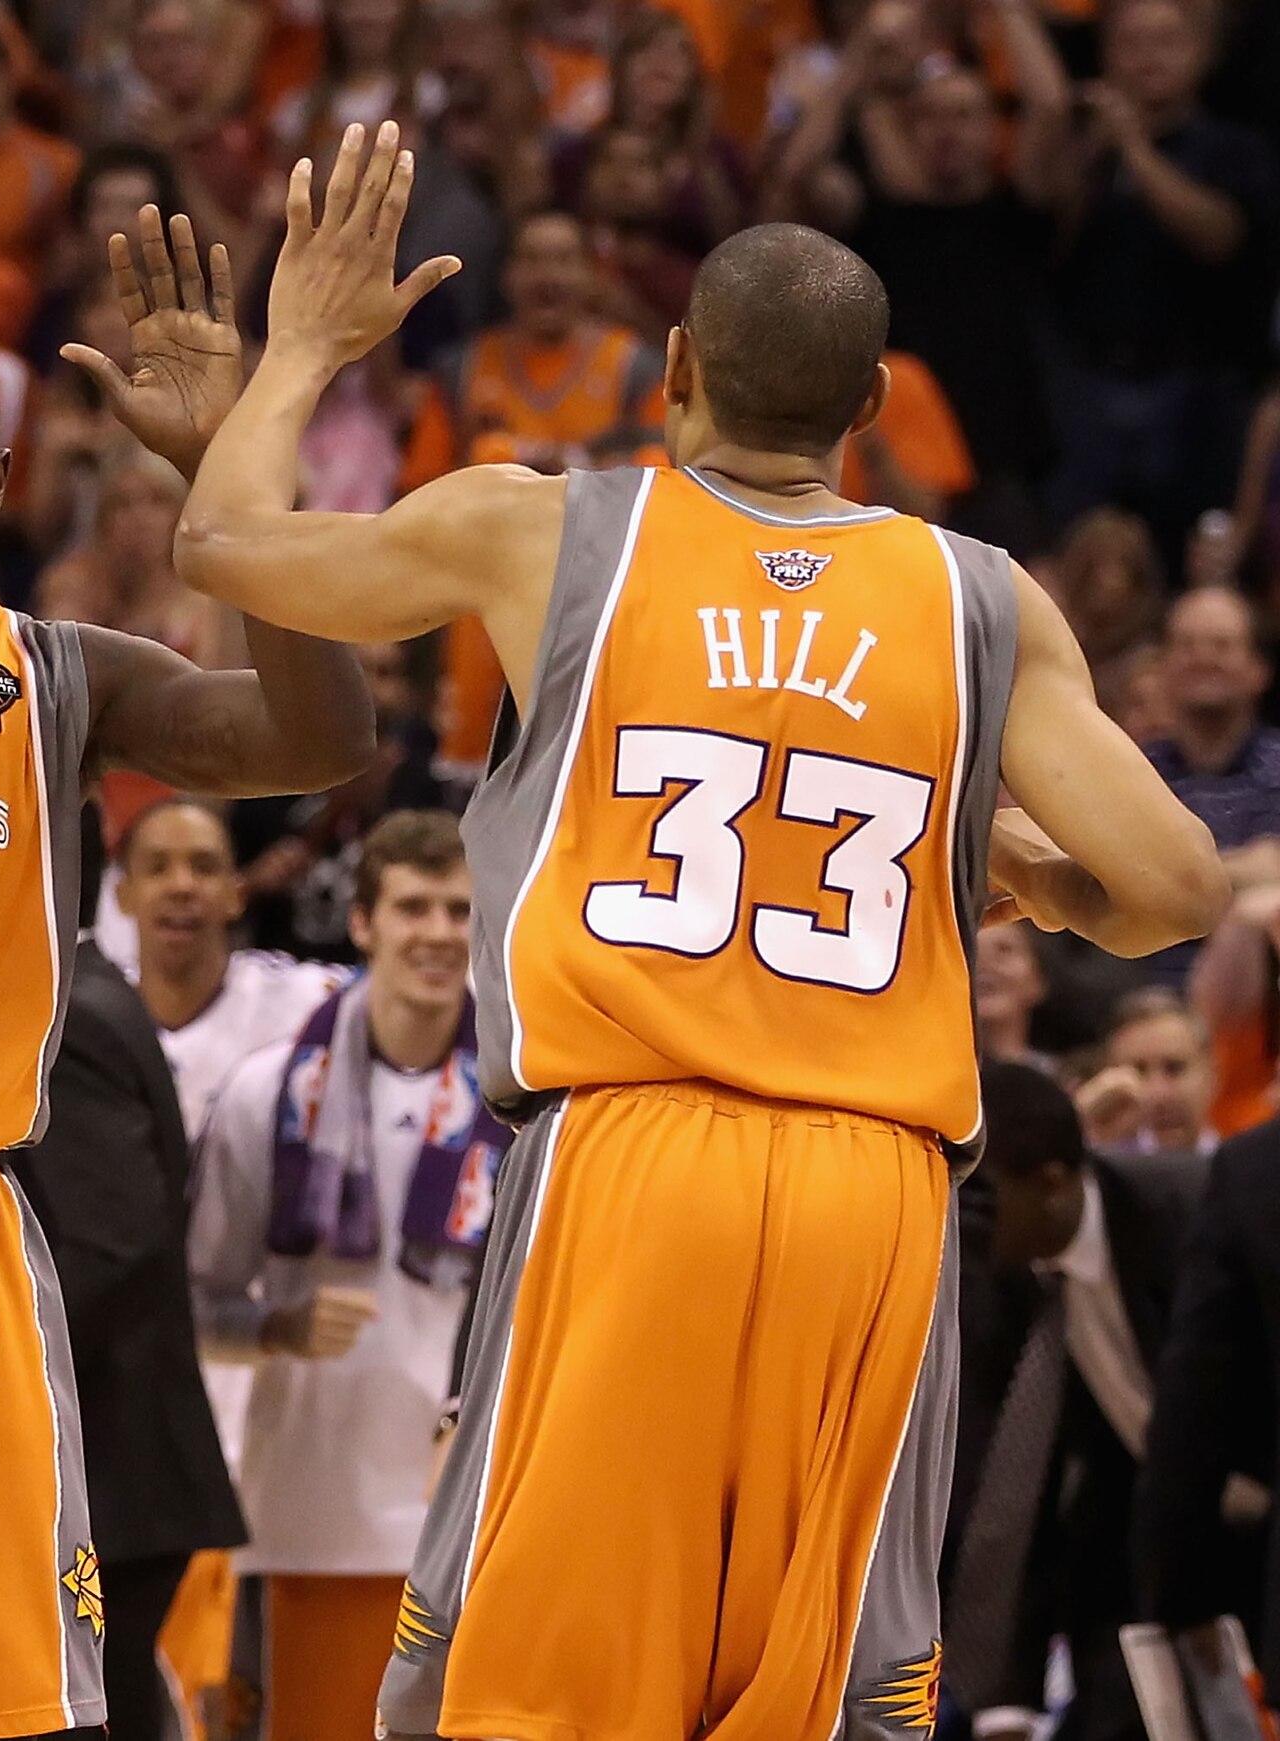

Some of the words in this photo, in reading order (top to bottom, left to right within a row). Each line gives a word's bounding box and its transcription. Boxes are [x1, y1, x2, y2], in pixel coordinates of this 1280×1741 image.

[773, 564, 812, 579] PHX
[696, 607, 878, 721] HILL
[582, 724, 937, 995] 33
